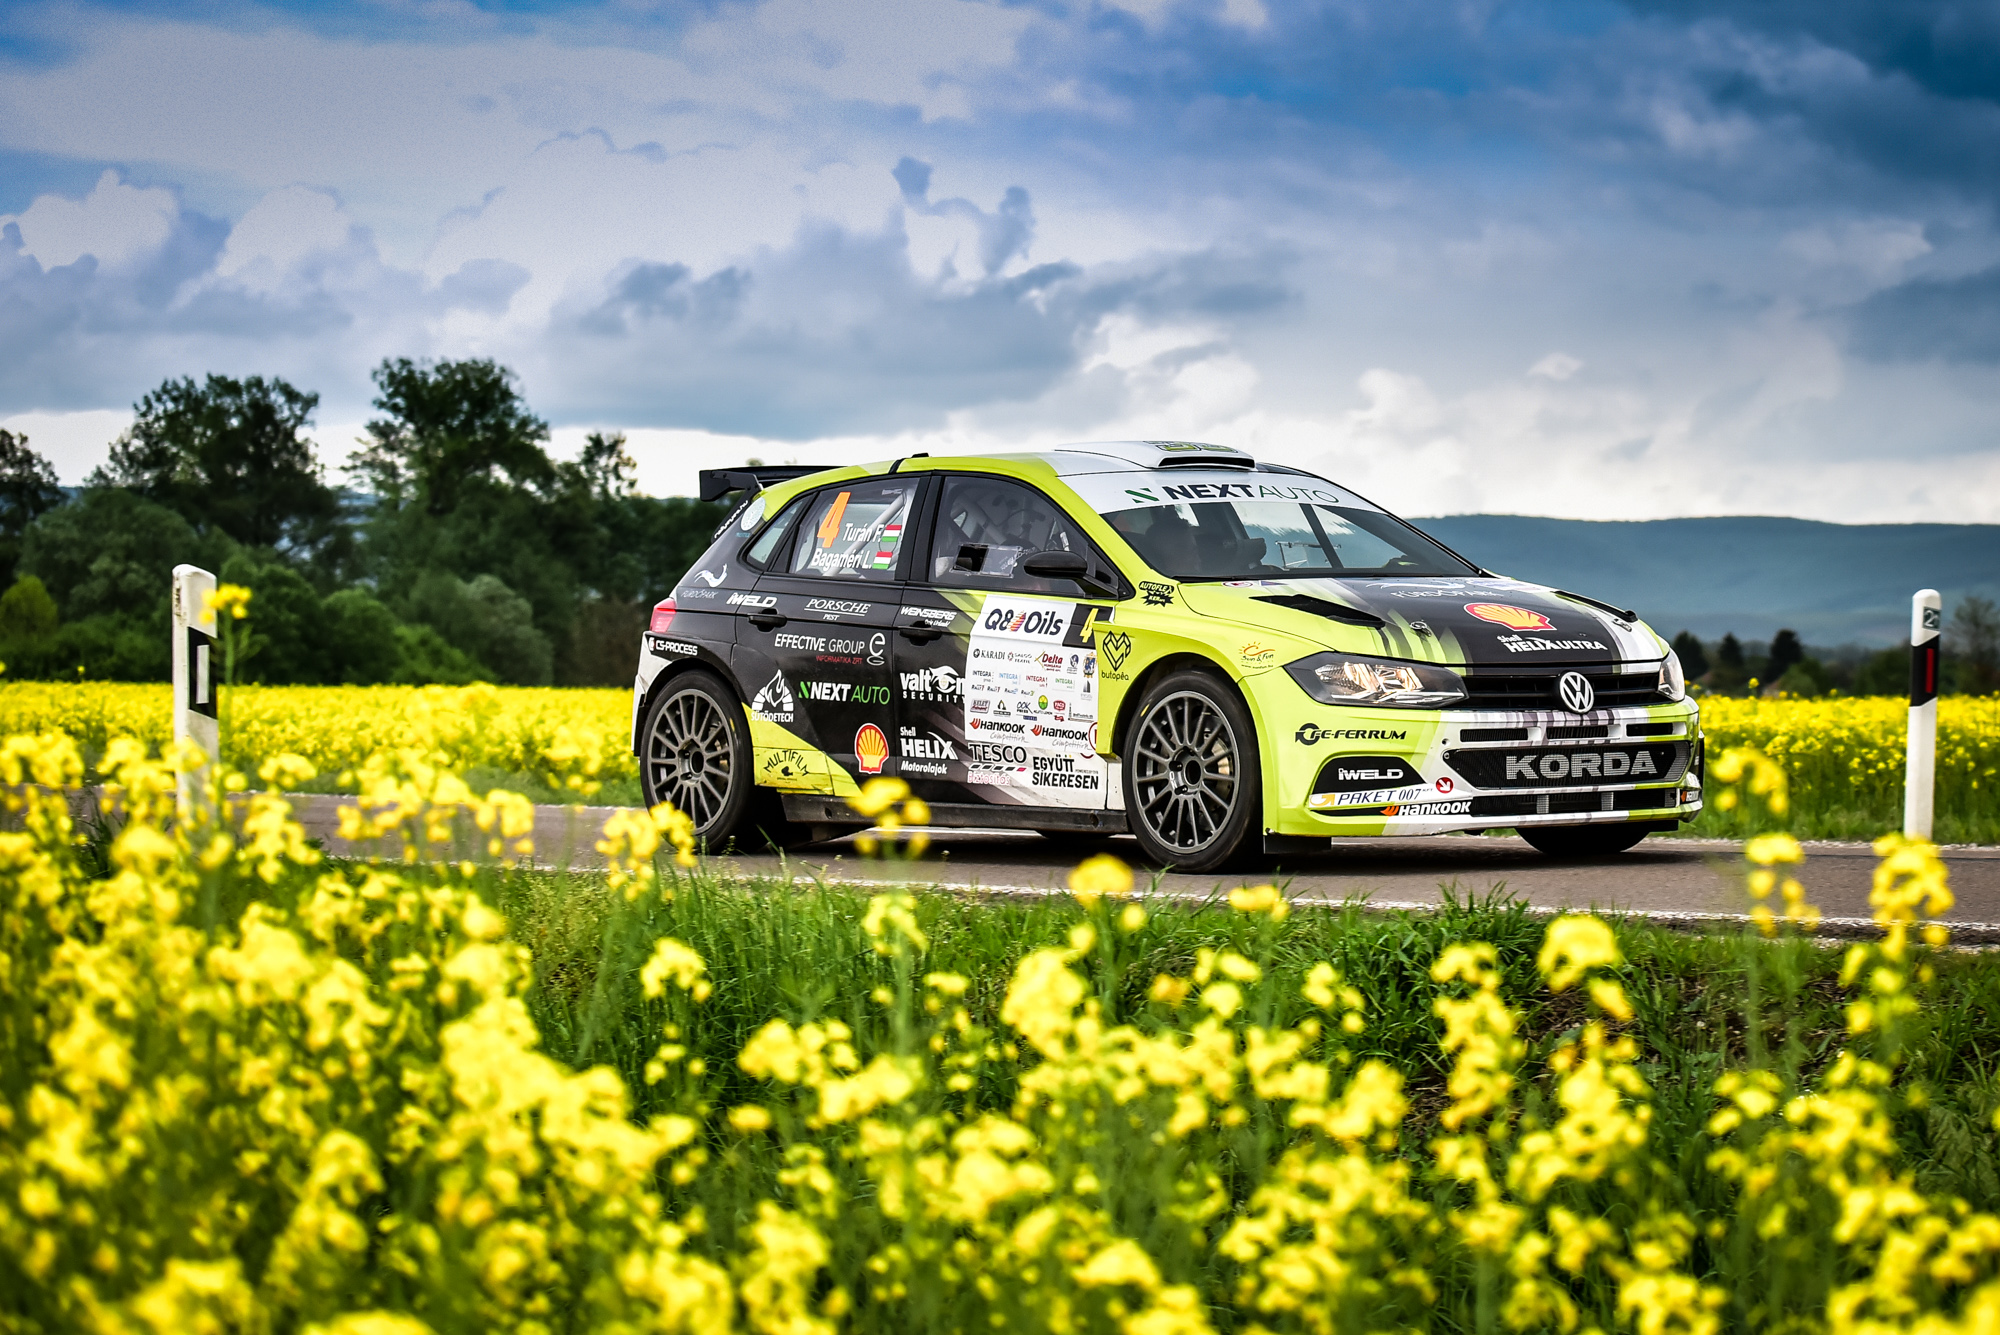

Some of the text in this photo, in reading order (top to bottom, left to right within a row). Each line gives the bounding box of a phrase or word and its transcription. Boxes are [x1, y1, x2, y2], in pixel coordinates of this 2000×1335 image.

[1162, 484, 1339, 503] NEXT AUTO
[817, 491, 851, 548] 4
[843, 523, 872, 541] Turán
[811, 548, 872, 571] Bagaméri L.
[806, 599, 871, 613] PORSCHE
[985, 608, 1063, 636] Q8 Oils
[1080, 608, 1098, 643] 4
[655, 641, 698, 655] CS-PROCESS
[775, 633, 865, 654] EFFECTIVE GROUP
[1497, 635, 1522, 644] Shell
[1503, 638, 1608, 652] HELIX ULTRA
[1042, 653, 1063, 664] Delta
[810, 681, 890, 704] NEXT AUTO
[900, 726, 916, 737] Shell
[900, 732, 958, 760] HELIX
[969, 744, 1027, 763] TESCO
[763, 749, 809, 776] MULTIFILM
[901, 761, 947, 776] Motorolajok
[1033, 754, 1075, 772] EGYÜTT
[1506, 751, 1658, 780] KORDA
[1338, 790, 1397, 805] PAKET
[1399, 789, 1421, 801] 007
